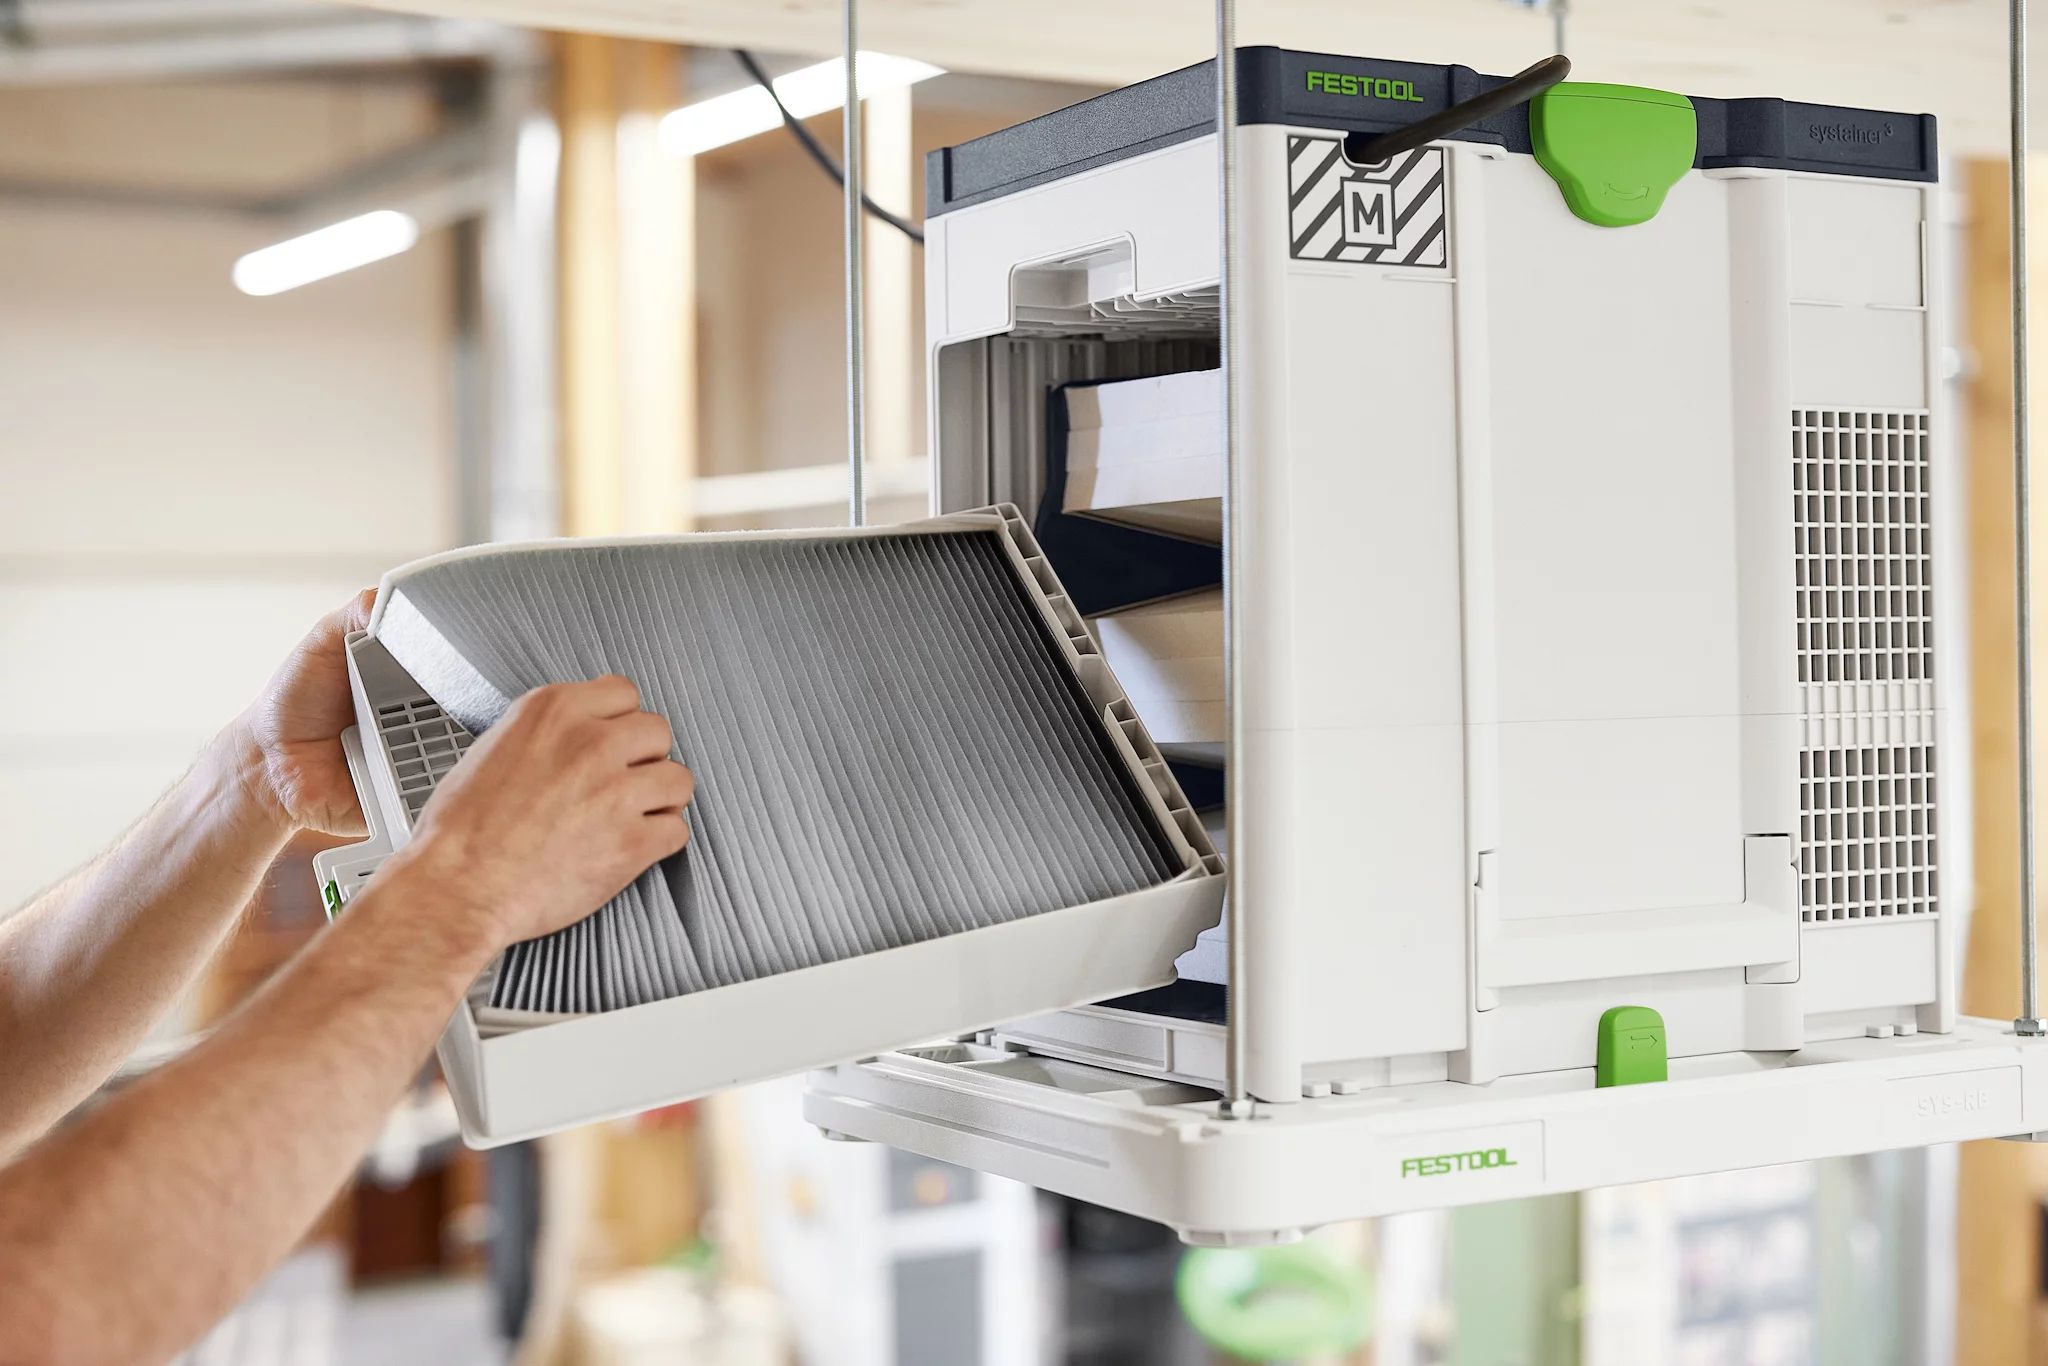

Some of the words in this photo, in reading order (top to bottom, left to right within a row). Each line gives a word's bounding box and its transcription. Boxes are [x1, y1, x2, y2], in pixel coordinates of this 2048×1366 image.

[1306, 71, 1424, 102] FESTOOL
[1352, 191, 1385, 235] M
[1402, 1148, 1518, 1179] FESTOOL
